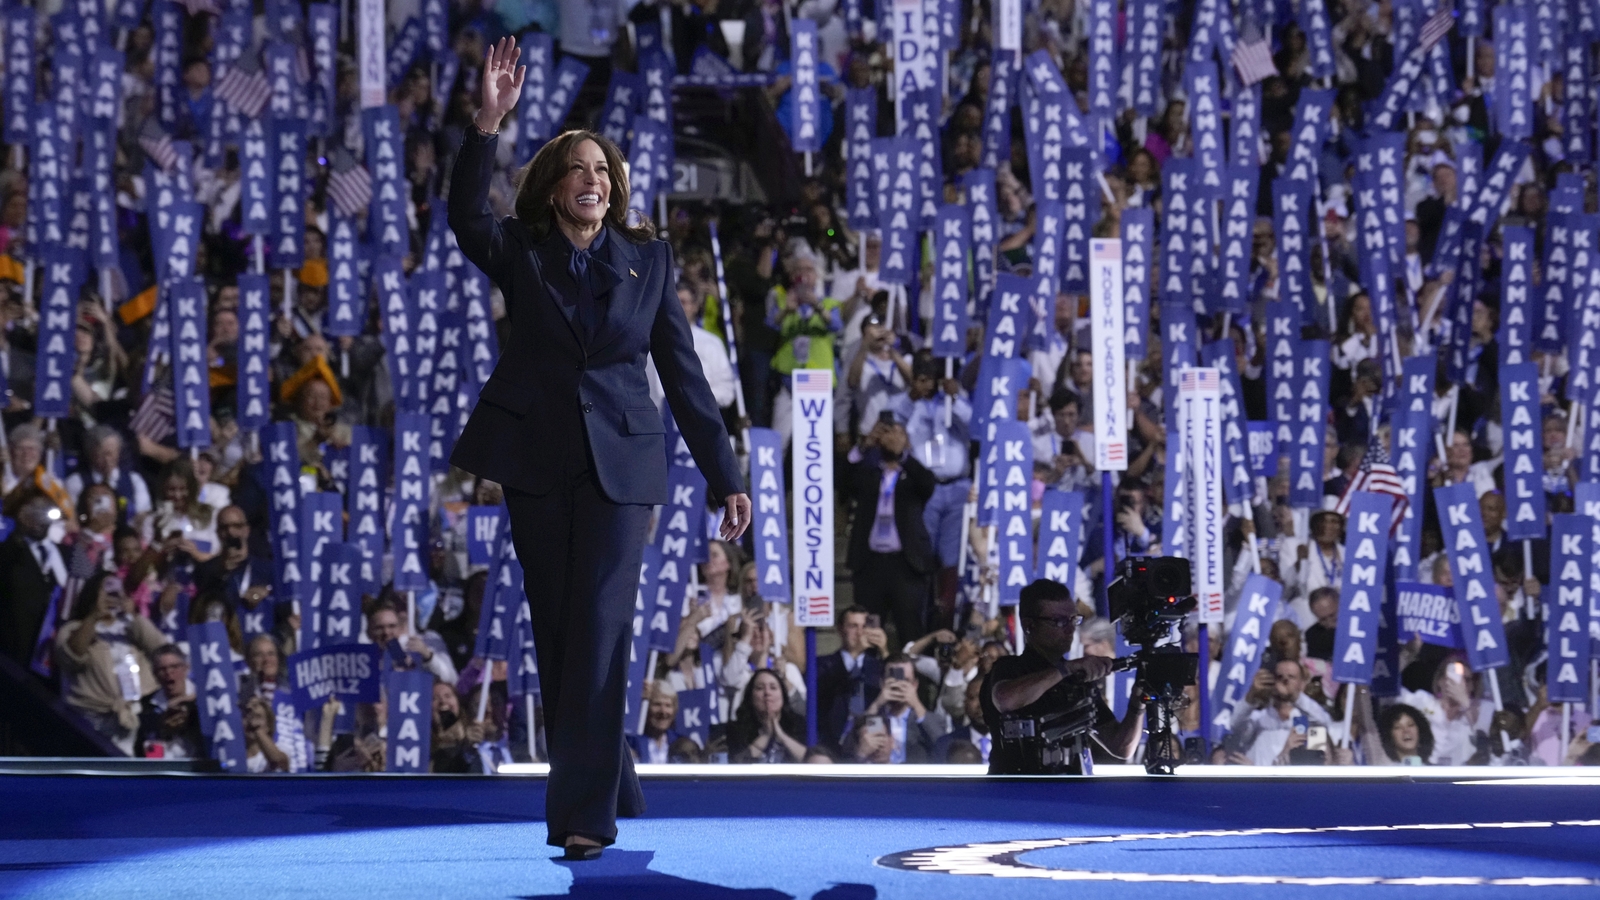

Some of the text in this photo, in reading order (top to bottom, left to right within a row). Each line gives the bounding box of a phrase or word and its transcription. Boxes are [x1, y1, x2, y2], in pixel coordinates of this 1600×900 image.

[11, 20, 30, 132] KAMALA
[161, 12, 179, 121] KAMALA
[796, 32, 816, 139] KAMALA
[983, 61, 1010, 168] KAMALA
[1094, 2, 1113, 107] KAMALA
[1138, 3, 1158, 105] KAMALA
[1509, 21, 1527, 125] KAMALA
[1567, 46, 1585, 152] KAMALA
[36, 117, 62, 242] KAMALA
[279, 132, 299, 254] KAMALA
[374, 119, 401, 244] KAMALA
[672, 162, 698, 193] 21
[852, 103, 871, 220] KAMALA
[1194, 75, 1219, 187] KAMALA
[885, 150, 916, 271] KAMALA
[1066, 161, 1087, 278] KAMALA
[1167, 171, 1188, 293] KAMALA
[1222, 179, 1250, 299] KAMALA
[43, 263, 71, 400] KAMALA
[939, 218, 964, 342] KAMALA
[1033, 215, 1058, 338] KAMALA
[1125, 222, 1145, 345] KAMALA
[1506, 242, 1528, 365] KAMALA
[1541, 227, 1568, 341] KAMALA
[178, 298, 204, 430] KAMALA
[244, 290, 264, 416] KAMALA
[430, 326, 461, 460] KAMALA
[1102, 265, 1117, 438] NORTH CAROLINA
[1272, 316, 1293, 442] KAMALA
[1212, 355, 1250, 488] KAMALA
[1296, 357, 1322, 491] KAMALA
[1508, 380, 1538, 523] KAMALA
[270, 440, 301, 583] KAMALA
[357, 443, 380, 581] KAMALA
[401, 431, 423, 574] KAMALA
[757, 446, 783, 586] KAMALA
[800, 399, 826, 592] WISCONSIN
[1003, 439, 1028, 587] KAMALA
[1203, 397, 1216, 585] TENNESSEE
[1393, 426, 1420, 567] KAMALA
[649, 483, 695, 633] KAMALA
[1343, 511, 1381, 665] KAMALA
[1396, 590, 1461, 625] HARRIS
[1446, 502, 1498, 652] KAMALA
[1557, 533, 1583, 684] KAMALA
[295, 651, 371, 688] HARRIS
[307, 678, 360, 700] WALZ
[1212, 592, 1270, 732] KAMALA
[1403, 616, 1450, 638] WALZ
